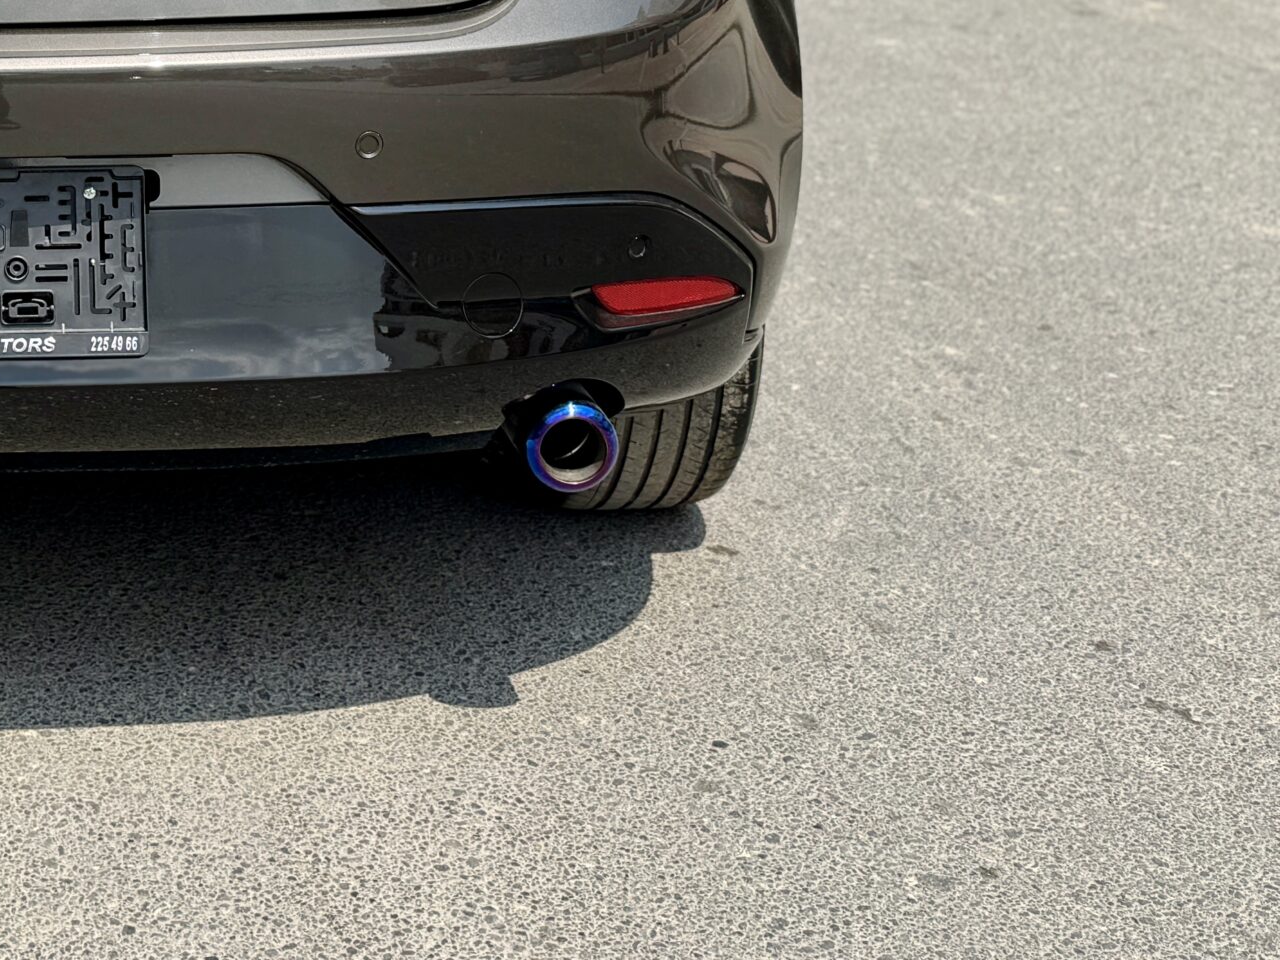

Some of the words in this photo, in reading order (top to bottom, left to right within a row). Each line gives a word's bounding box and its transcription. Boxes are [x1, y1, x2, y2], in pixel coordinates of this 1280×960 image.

[90, 335, 110, 352] 225
[110, 335, 124, 351] 49
[125, 336, 139, 351] 66
